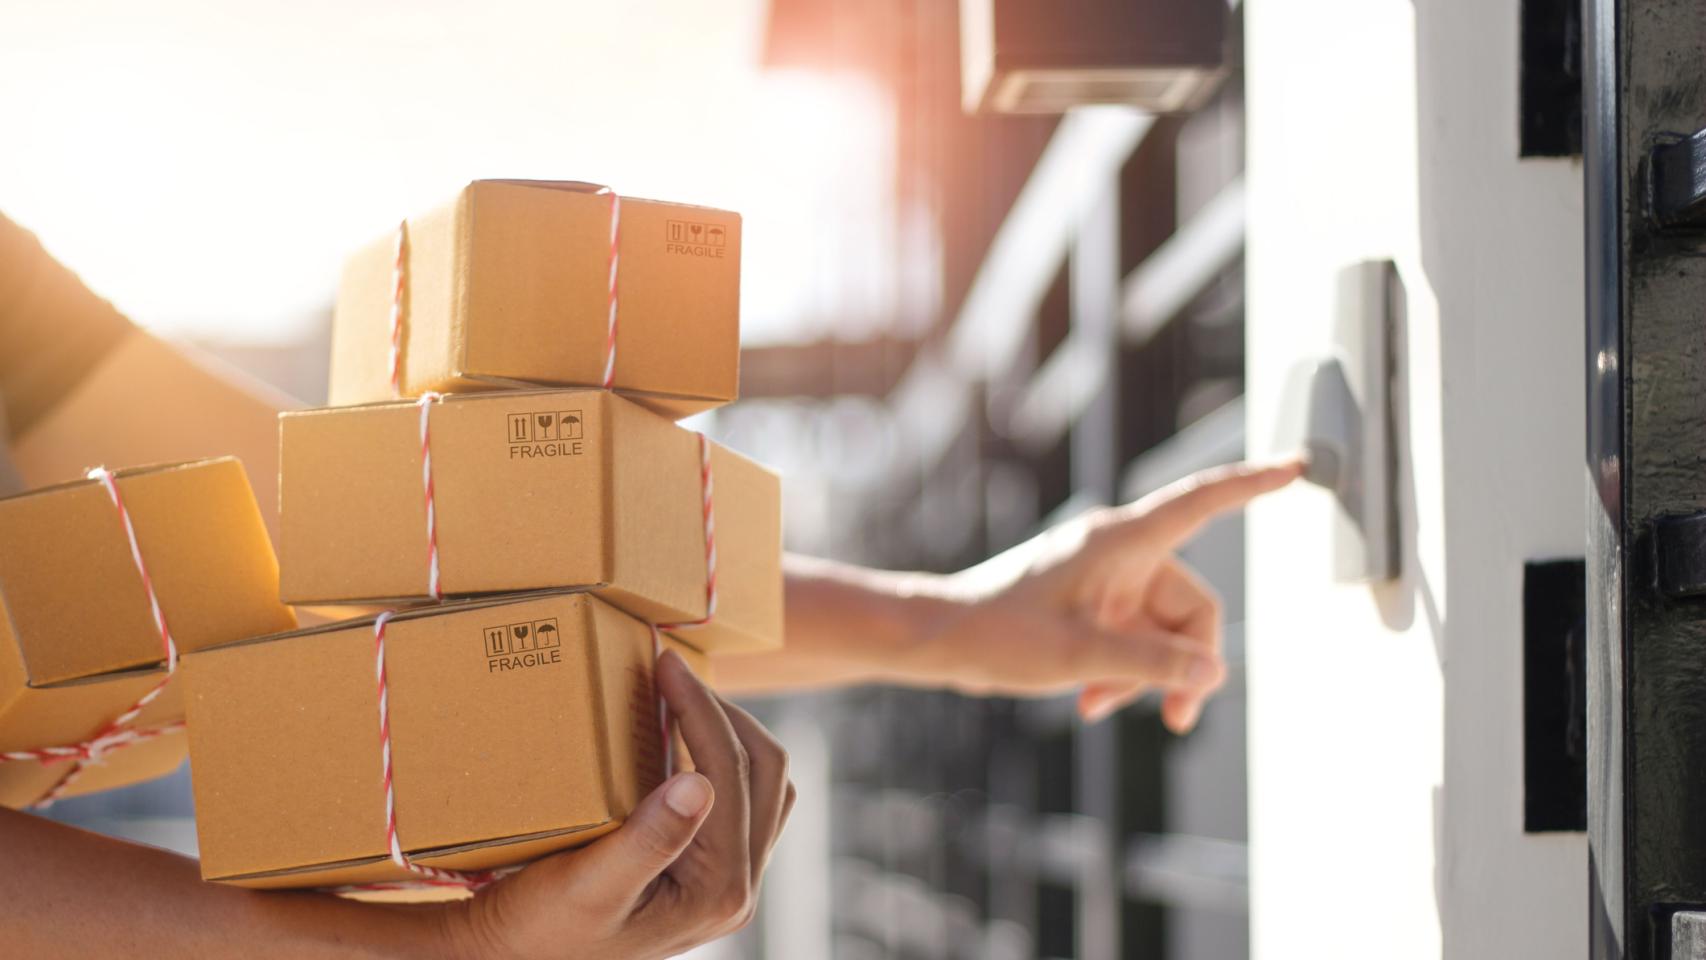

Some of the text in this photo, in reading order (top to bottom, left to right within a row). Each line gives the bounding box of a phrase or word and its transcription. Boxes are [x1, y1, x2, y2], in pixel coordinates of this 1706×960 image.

[666, 243, 725, 258] FRAGILE
[510, 442, 583, 459] FRAGILE
[489, 650, 561, 672] FRAGILE
